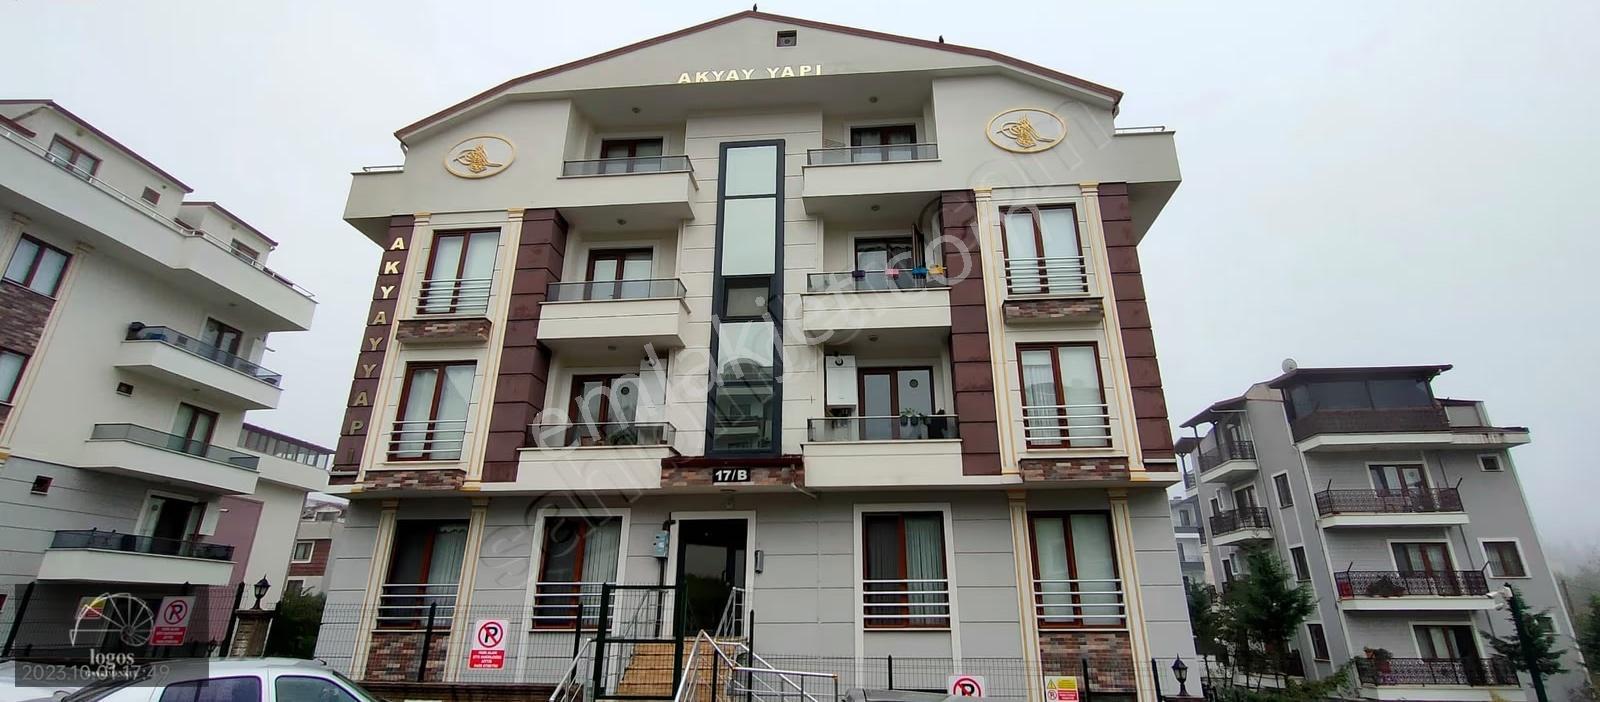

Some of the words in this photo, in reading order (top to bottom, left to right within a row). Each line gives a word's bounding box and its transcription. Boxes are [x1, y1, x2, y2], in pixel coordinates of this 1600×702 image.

[678, 68, 755, 84] AKYAY
[766, 64, 822, 78] YAPI
[368, 236, 406, 351] AKYAY
[347, 363, 377, 464] YAPI
[715, 469, 748, 481] 17/B
